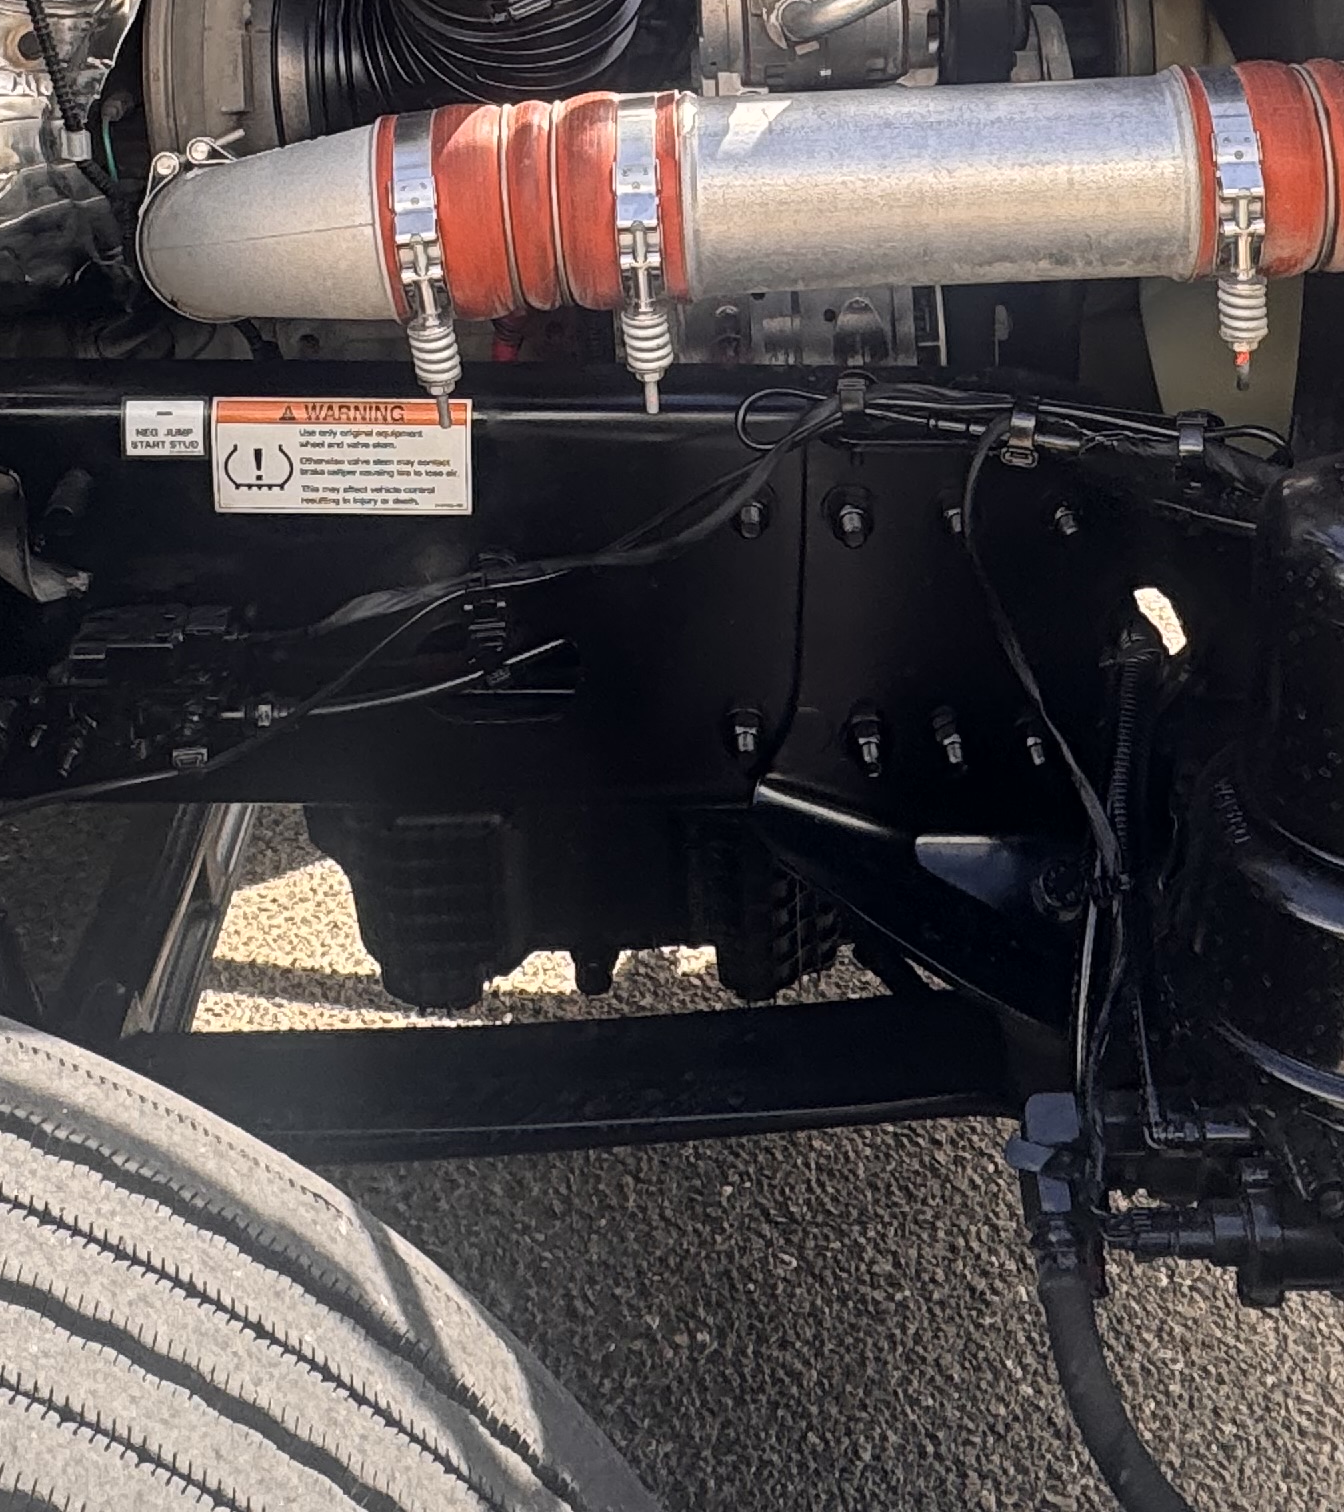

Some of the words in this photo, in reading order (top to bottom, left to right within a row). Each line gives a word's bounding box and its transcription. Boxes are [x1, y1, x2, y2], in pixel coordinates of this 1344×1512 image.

[305, 404, 405, 423] WARNING
[135, 428, 158, 437] NEG
[163, 428, 194, 437] JUMP
[319, 429, 337, 438] only
[339, 429, 373, 438] original
[376, 430, 423, 439] equipment
[130, 440, 166, 449] START
[169, 440, 200, 449] STUD
[301, 497, 339, 505] resulting
[353, 498, 378, 506] injury
